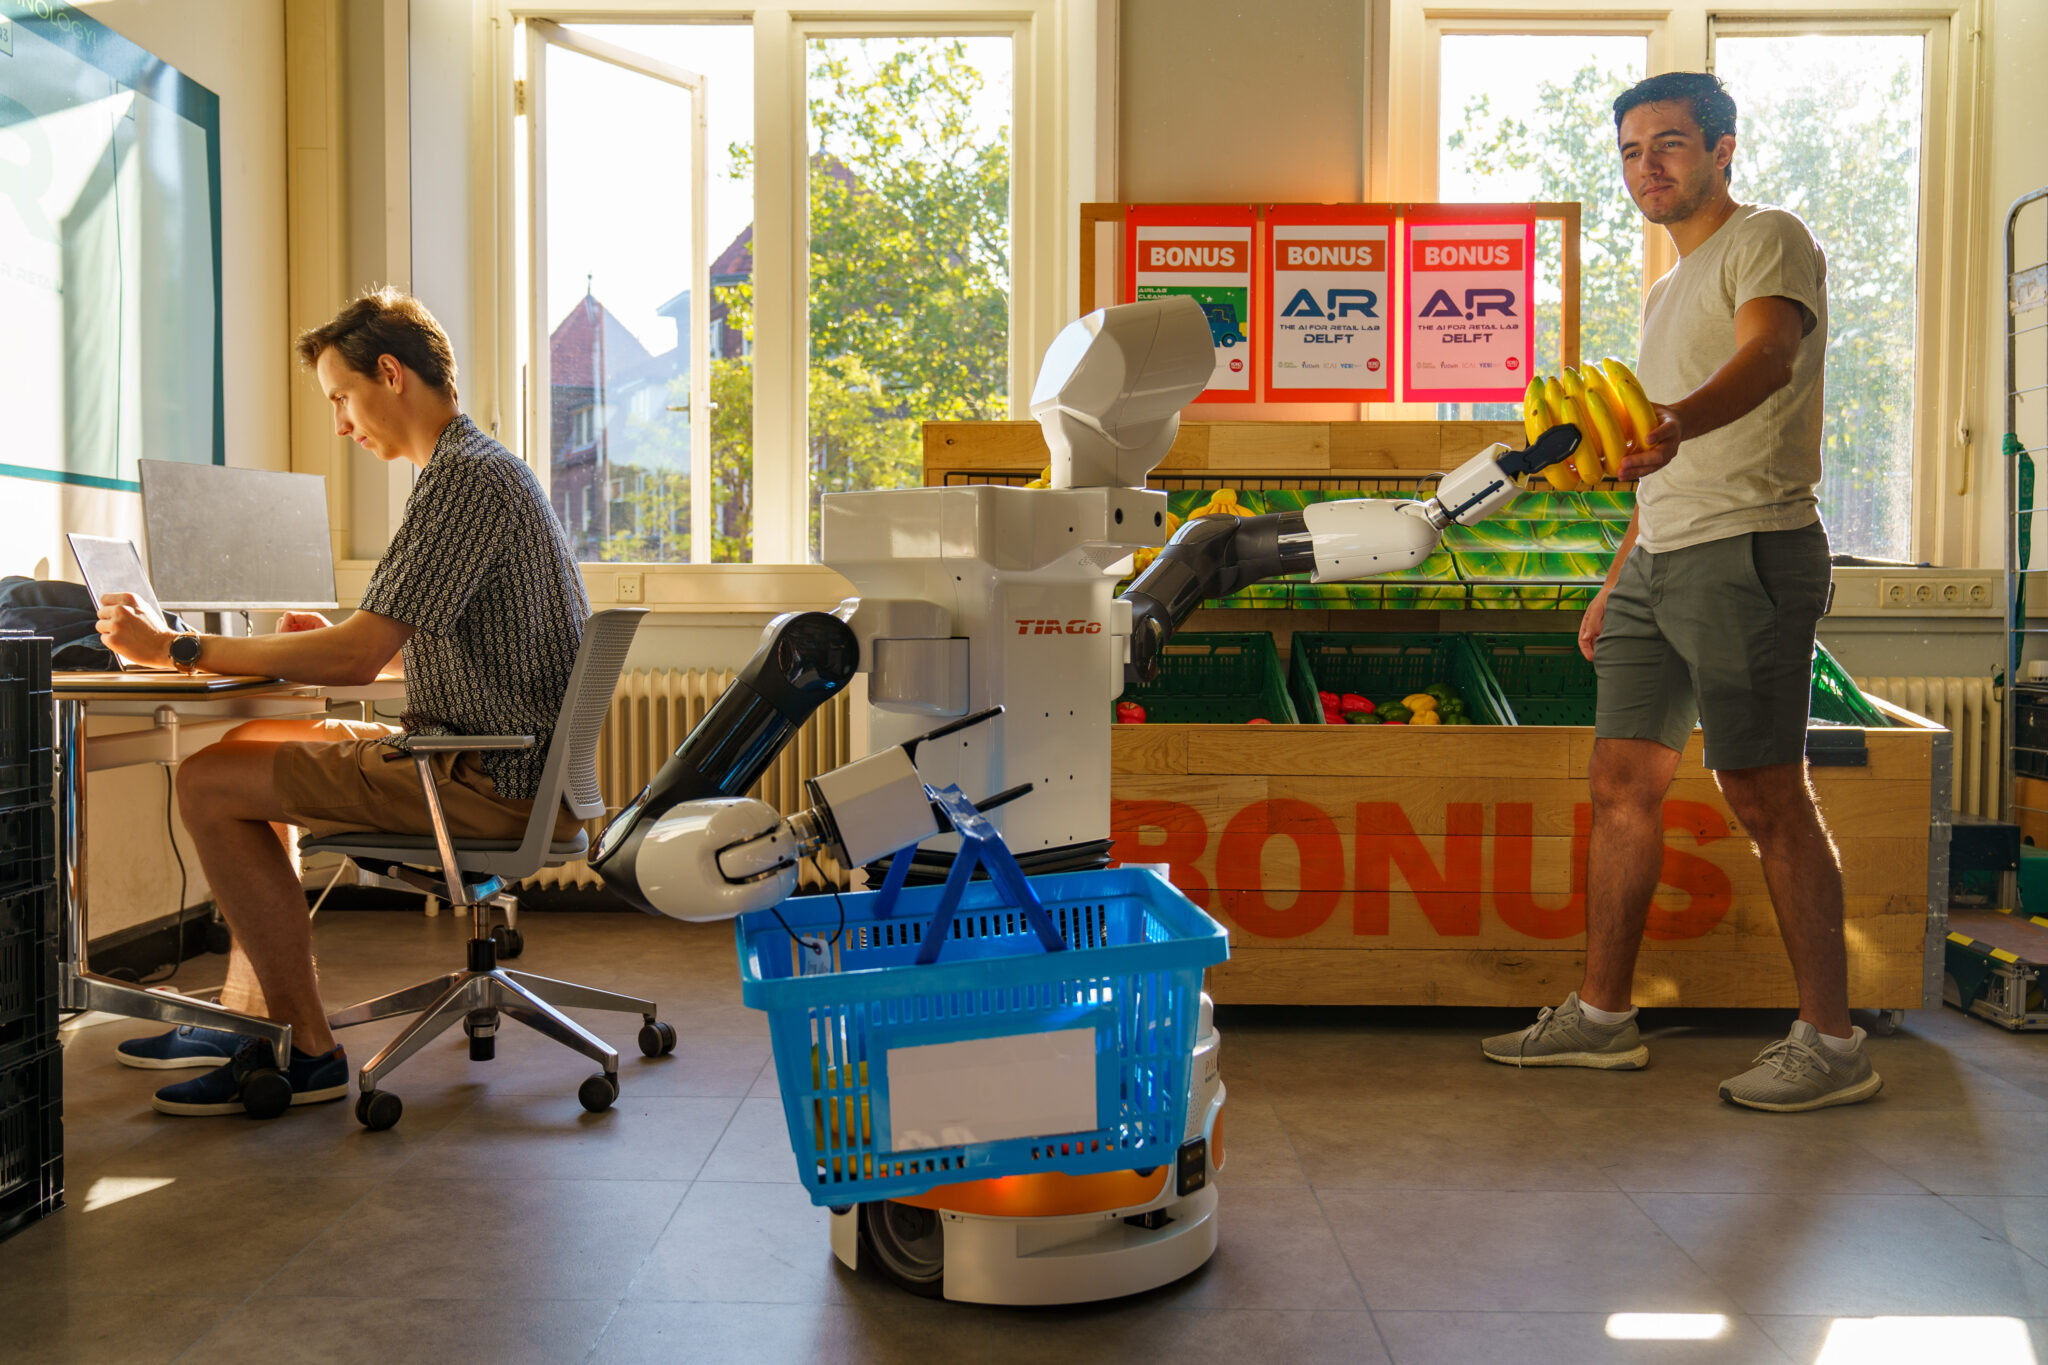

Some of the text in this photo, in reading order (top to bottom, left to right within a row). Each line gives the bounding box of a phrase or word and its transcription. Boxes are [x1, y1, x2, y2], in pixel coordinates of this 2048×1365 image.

[1150, 246, 1236, 267] BONUS
[1287, 246, 1373, 266] BONUS
[1424, 245, 1511, 266] BONUS
[1303, 333, 1355, 344] DELFT
[1442, 333, 1493, 343] DELFT
[1110, 799, 1732, 940] BONUS
